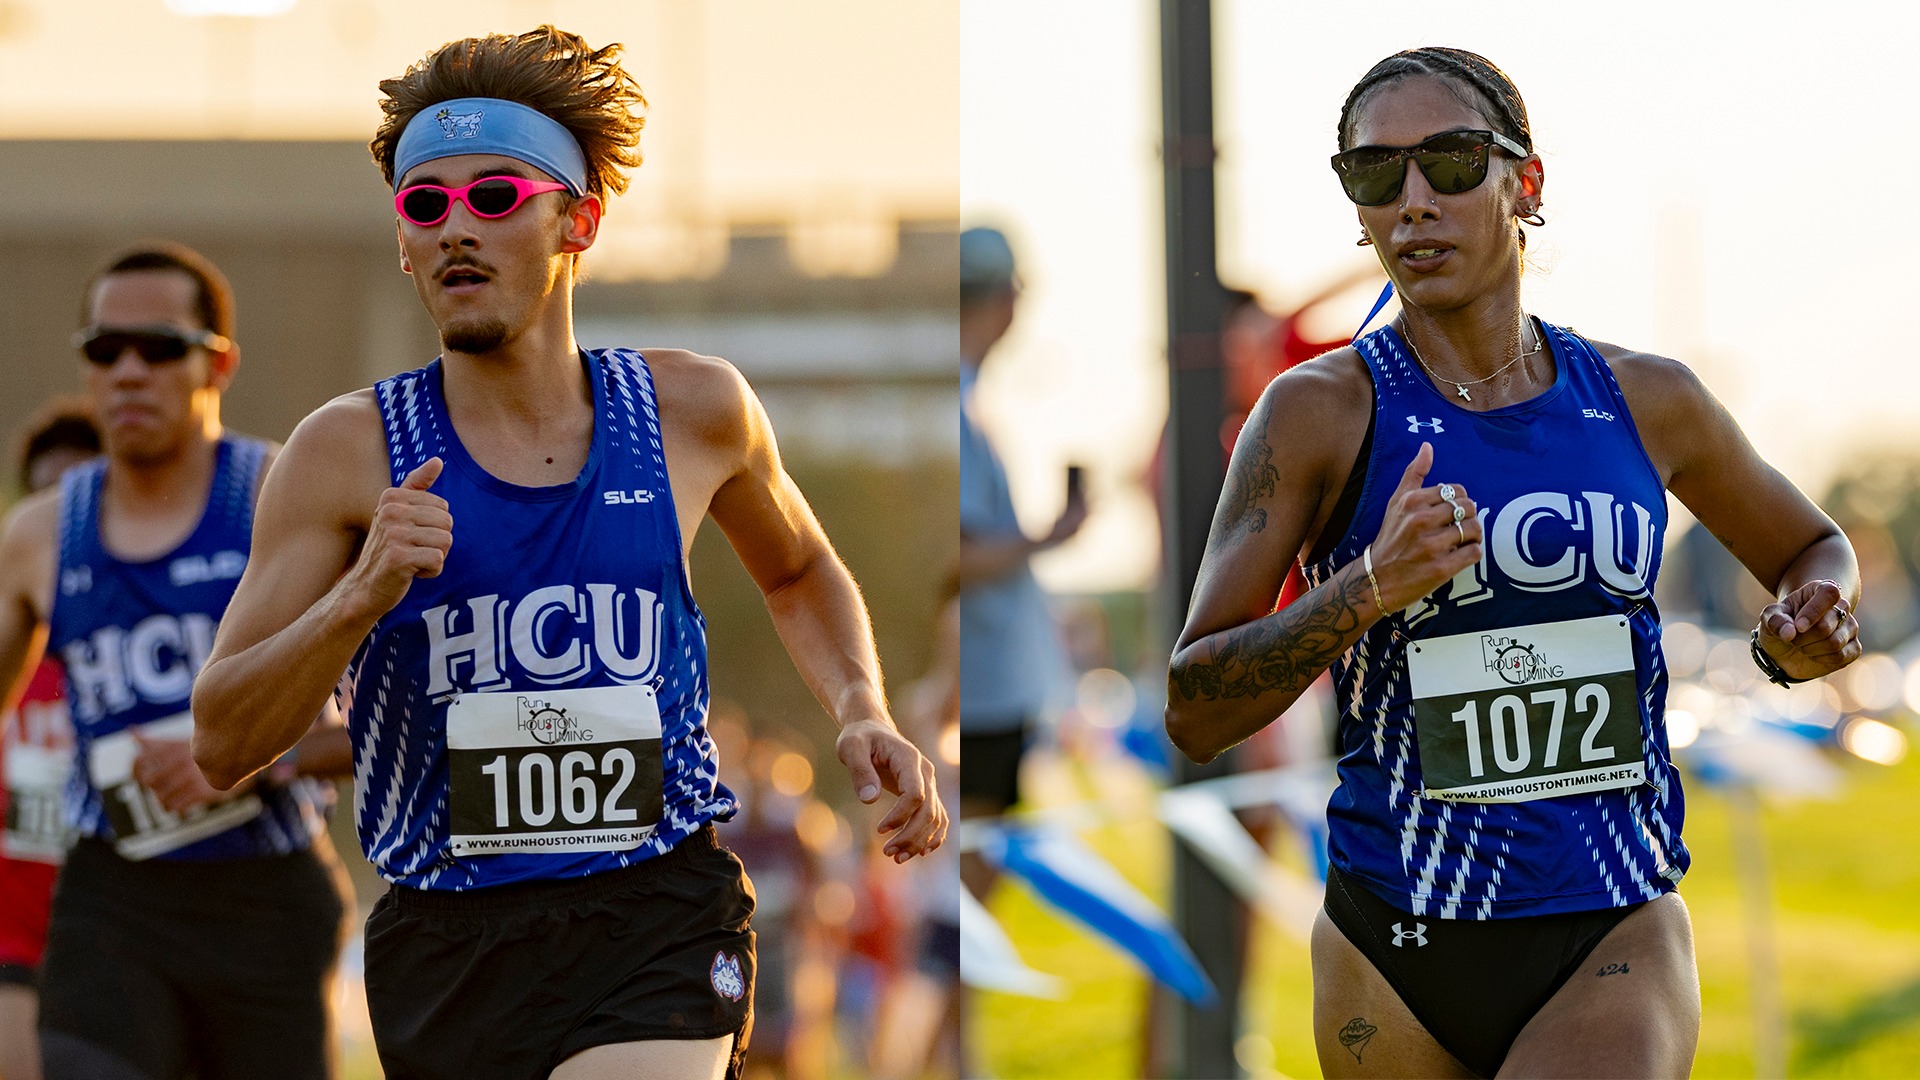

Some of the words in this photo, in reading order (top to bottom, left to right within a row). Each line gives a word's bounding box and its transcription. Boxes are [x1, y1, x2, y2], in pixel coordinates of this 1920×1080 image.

[421, 583, 665, 706] HCU
[1481, 635, 1510, 647] Run
[1484, 653, 1547, 673] HOUSTON
[517, 696, 544, 708] Run
[518, 717, 578, 732] HOUSTON
[1451, 683, 1615, 778] 1072
[482, 747, 638, 828] 1062
[1442, 769, 1632, 799] WWW.RUNHOUSTONTIMING.NET
[467, 831, 649, 849] WWW.RUNHOUSTONTIMING.NET
[1596, 962, 1630, 977] 424
